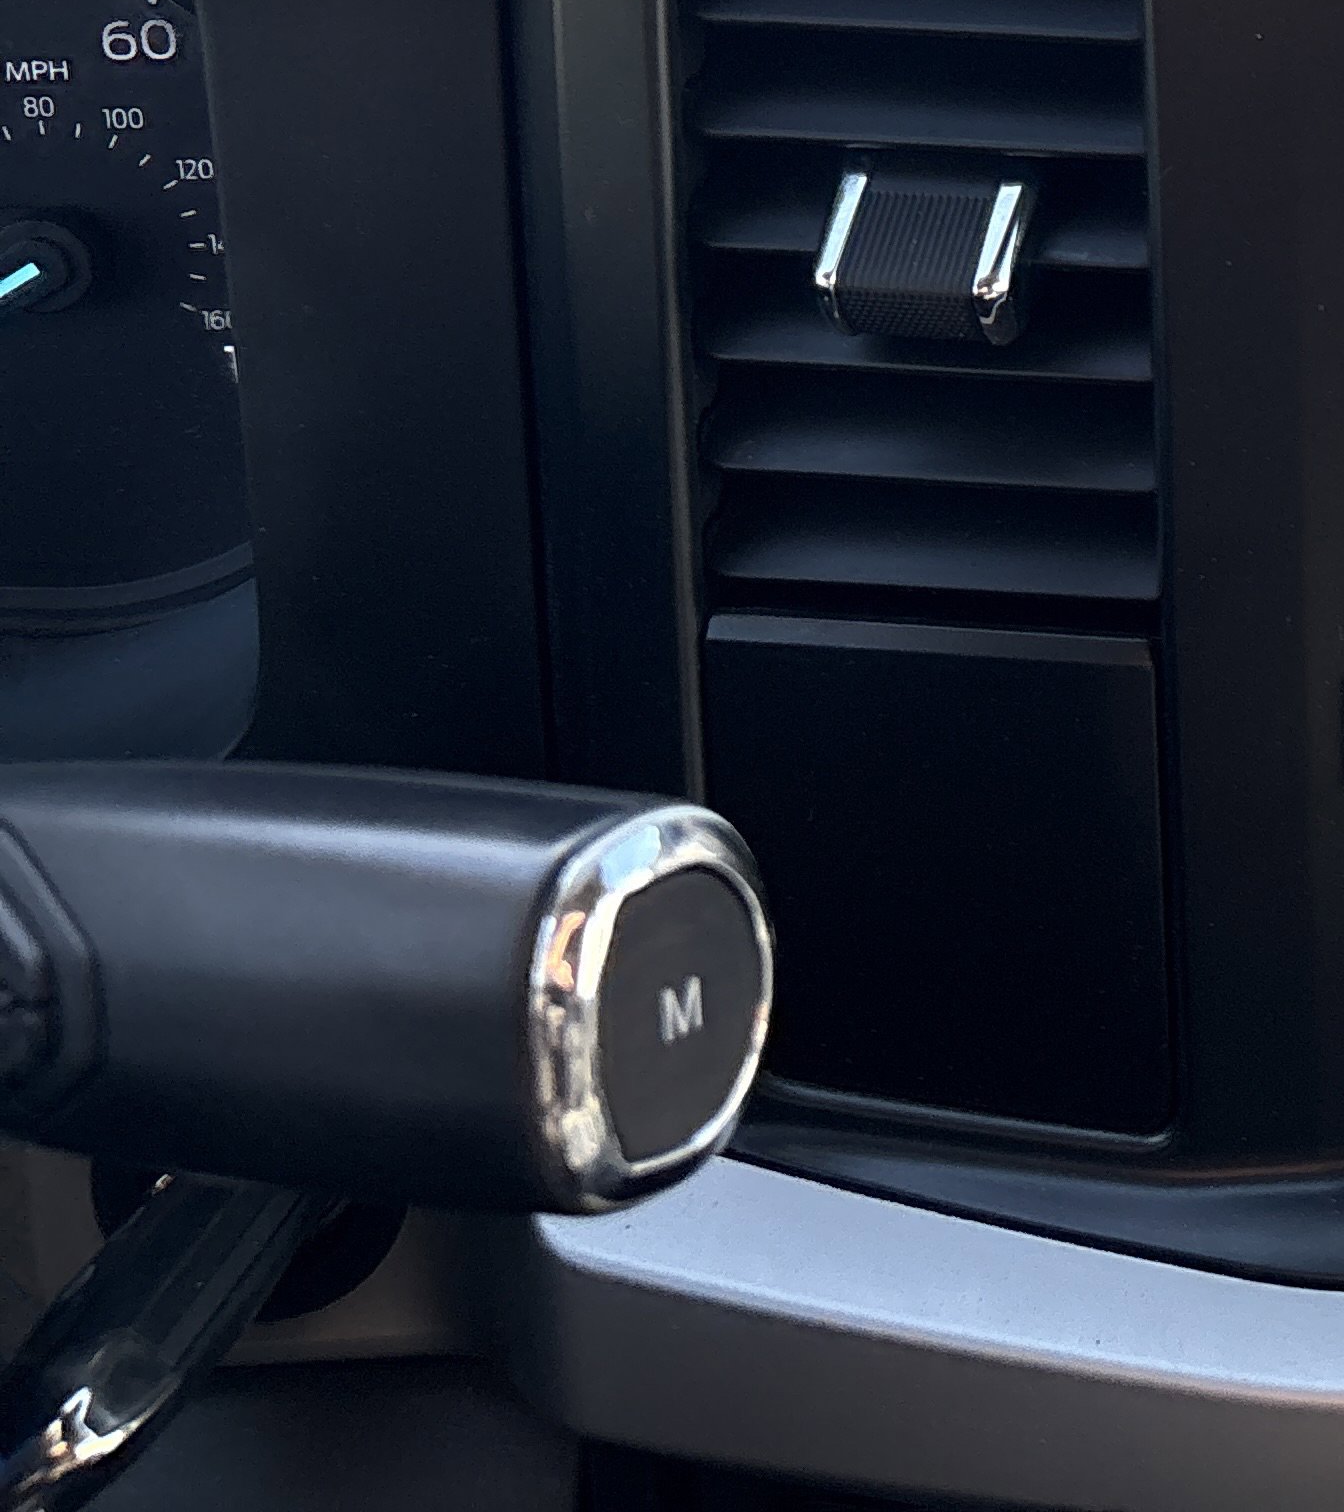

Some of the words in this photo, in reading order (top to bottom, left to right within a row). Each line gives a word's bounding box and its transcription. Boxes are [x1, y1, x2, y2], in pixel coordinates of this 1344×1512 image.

[102, 19, 177, 61] 60
[6, 60, 69, 82] MPH
[23, 96, 55, 118] 80
[102, 107, 144, 129] 100
[176, 159, 214, 180] 120
[660, 975, 703, 1044] M
